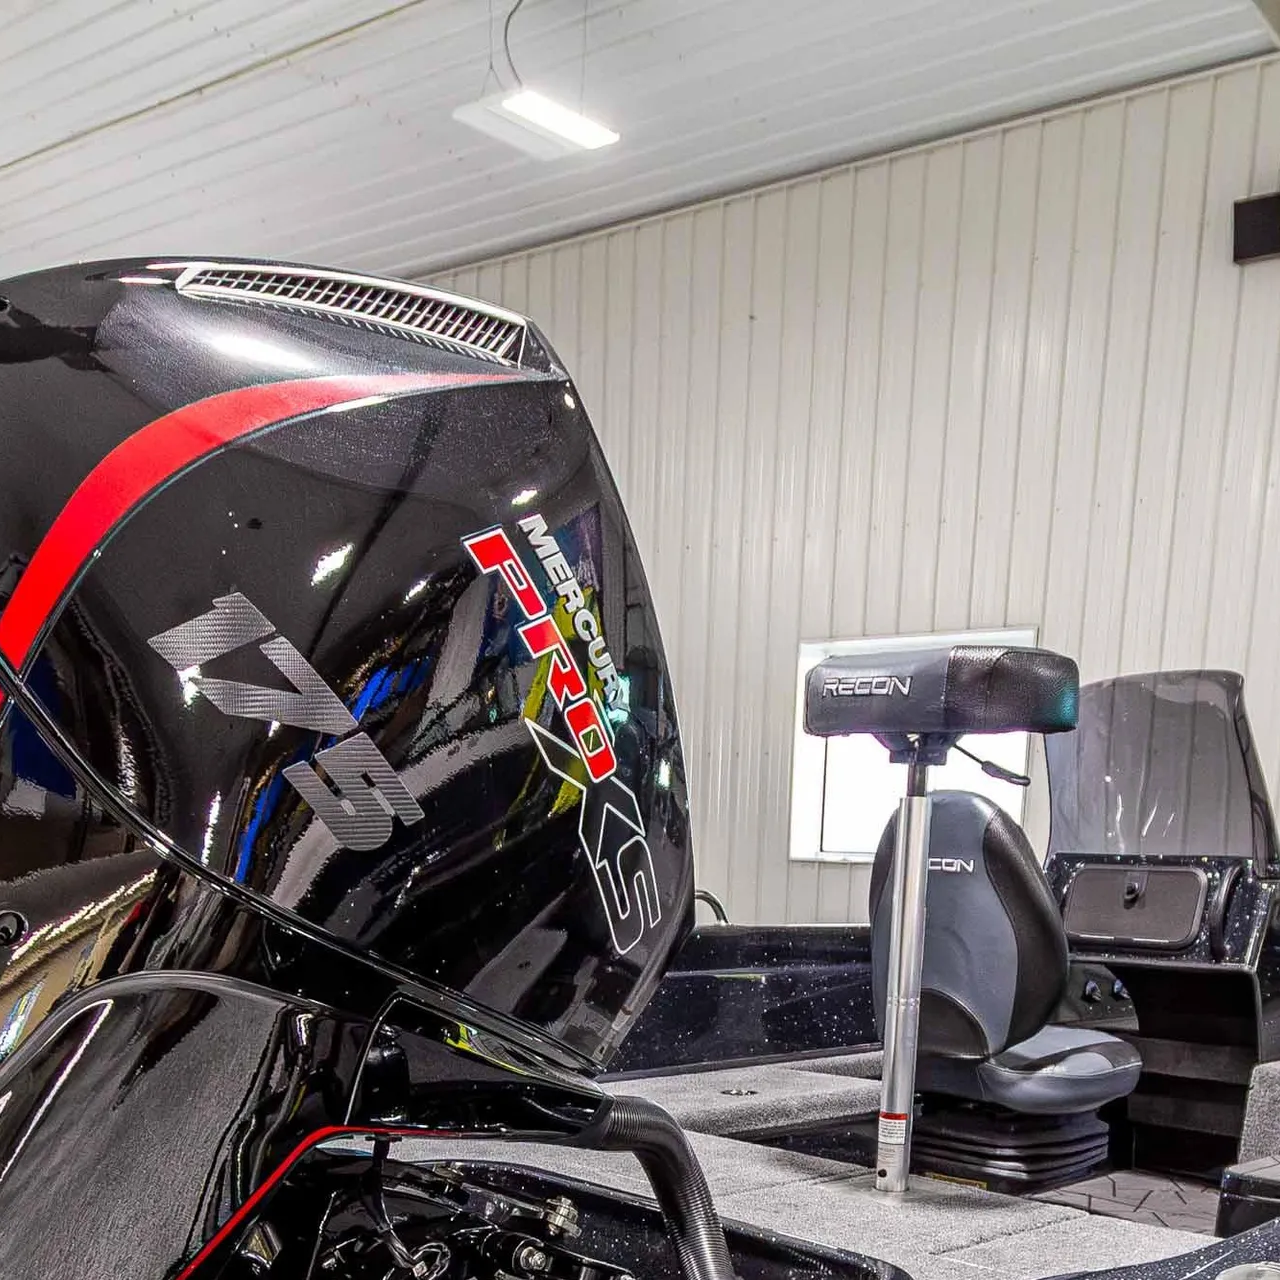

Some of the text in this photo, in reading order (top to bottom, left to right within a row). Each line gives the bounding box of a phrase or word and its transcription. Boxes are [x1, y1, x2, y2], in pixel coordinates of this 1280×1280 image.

[147, 592, 424, 852] 175
[518, 513, 631, 722] MERCURY
[822, 675, 913, 697] RECON
[460, 524, 662, 955] PRO XS
[928, 858, 974, 873] CON
